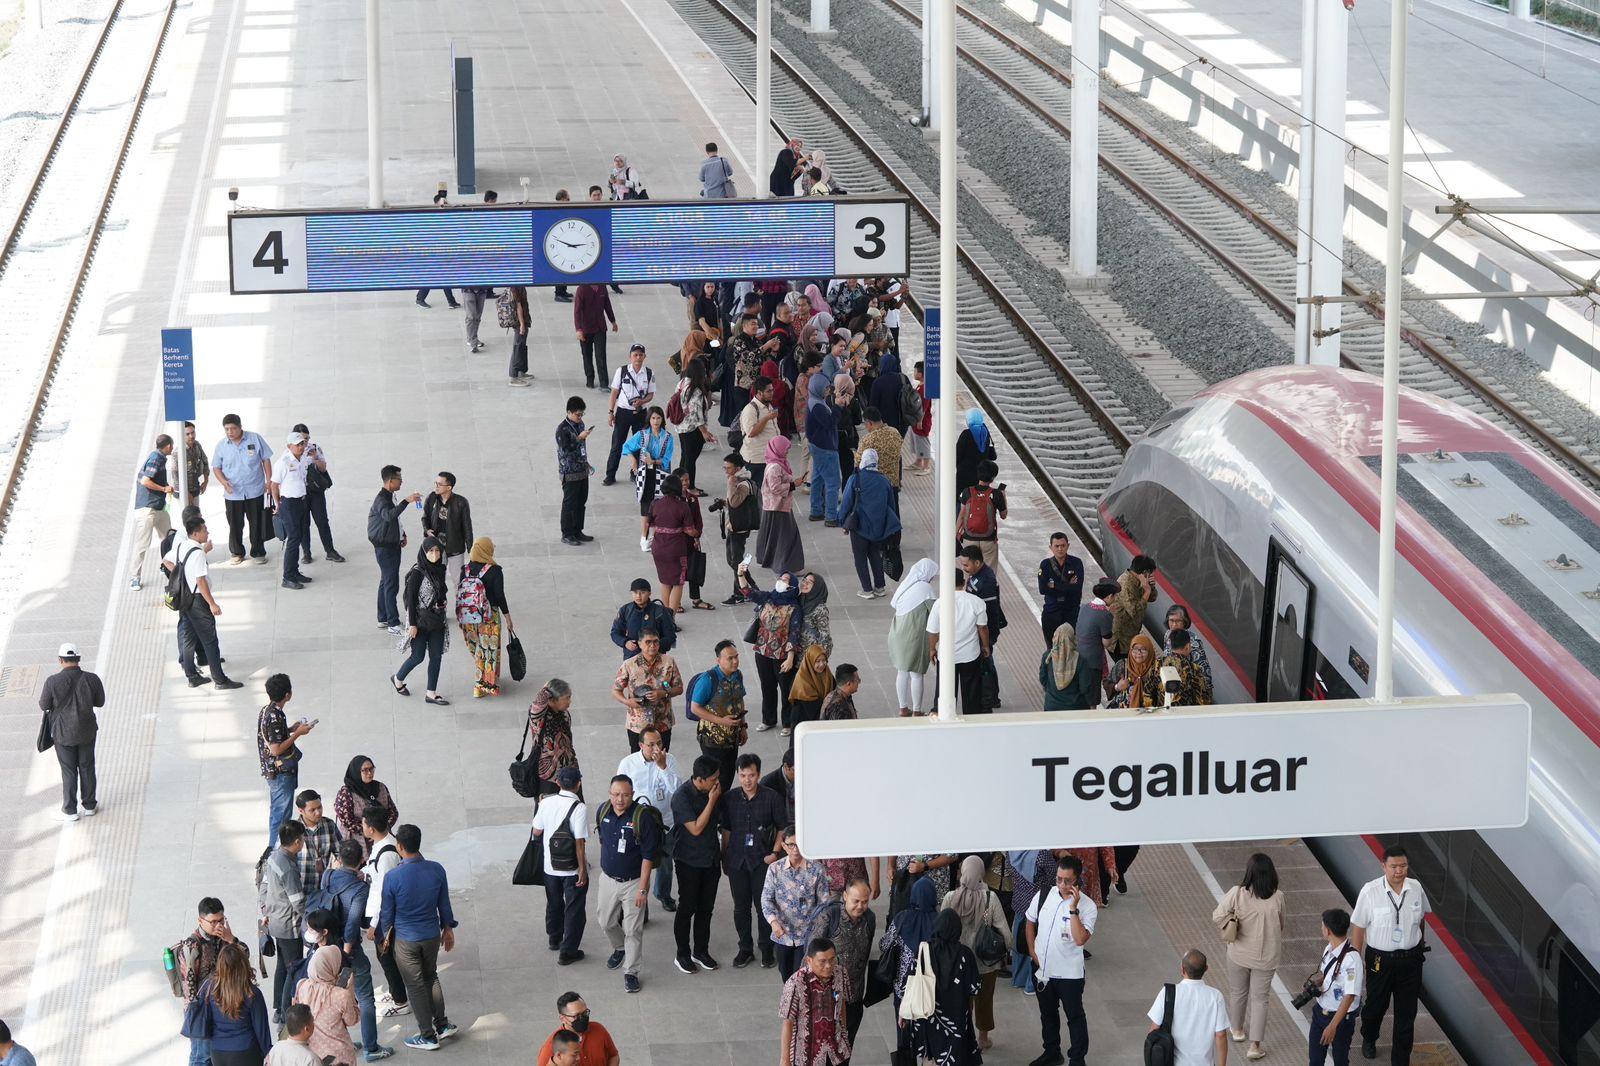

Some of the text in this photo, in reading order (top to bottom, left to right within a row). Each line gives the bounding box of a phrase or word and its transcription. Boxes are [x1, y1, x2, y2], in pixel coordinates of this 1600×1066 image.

[253, 231, 289, 274] 4
[854, 217, 886, 259] 3
[1032, 751, 1308, 812] Tegalluar
